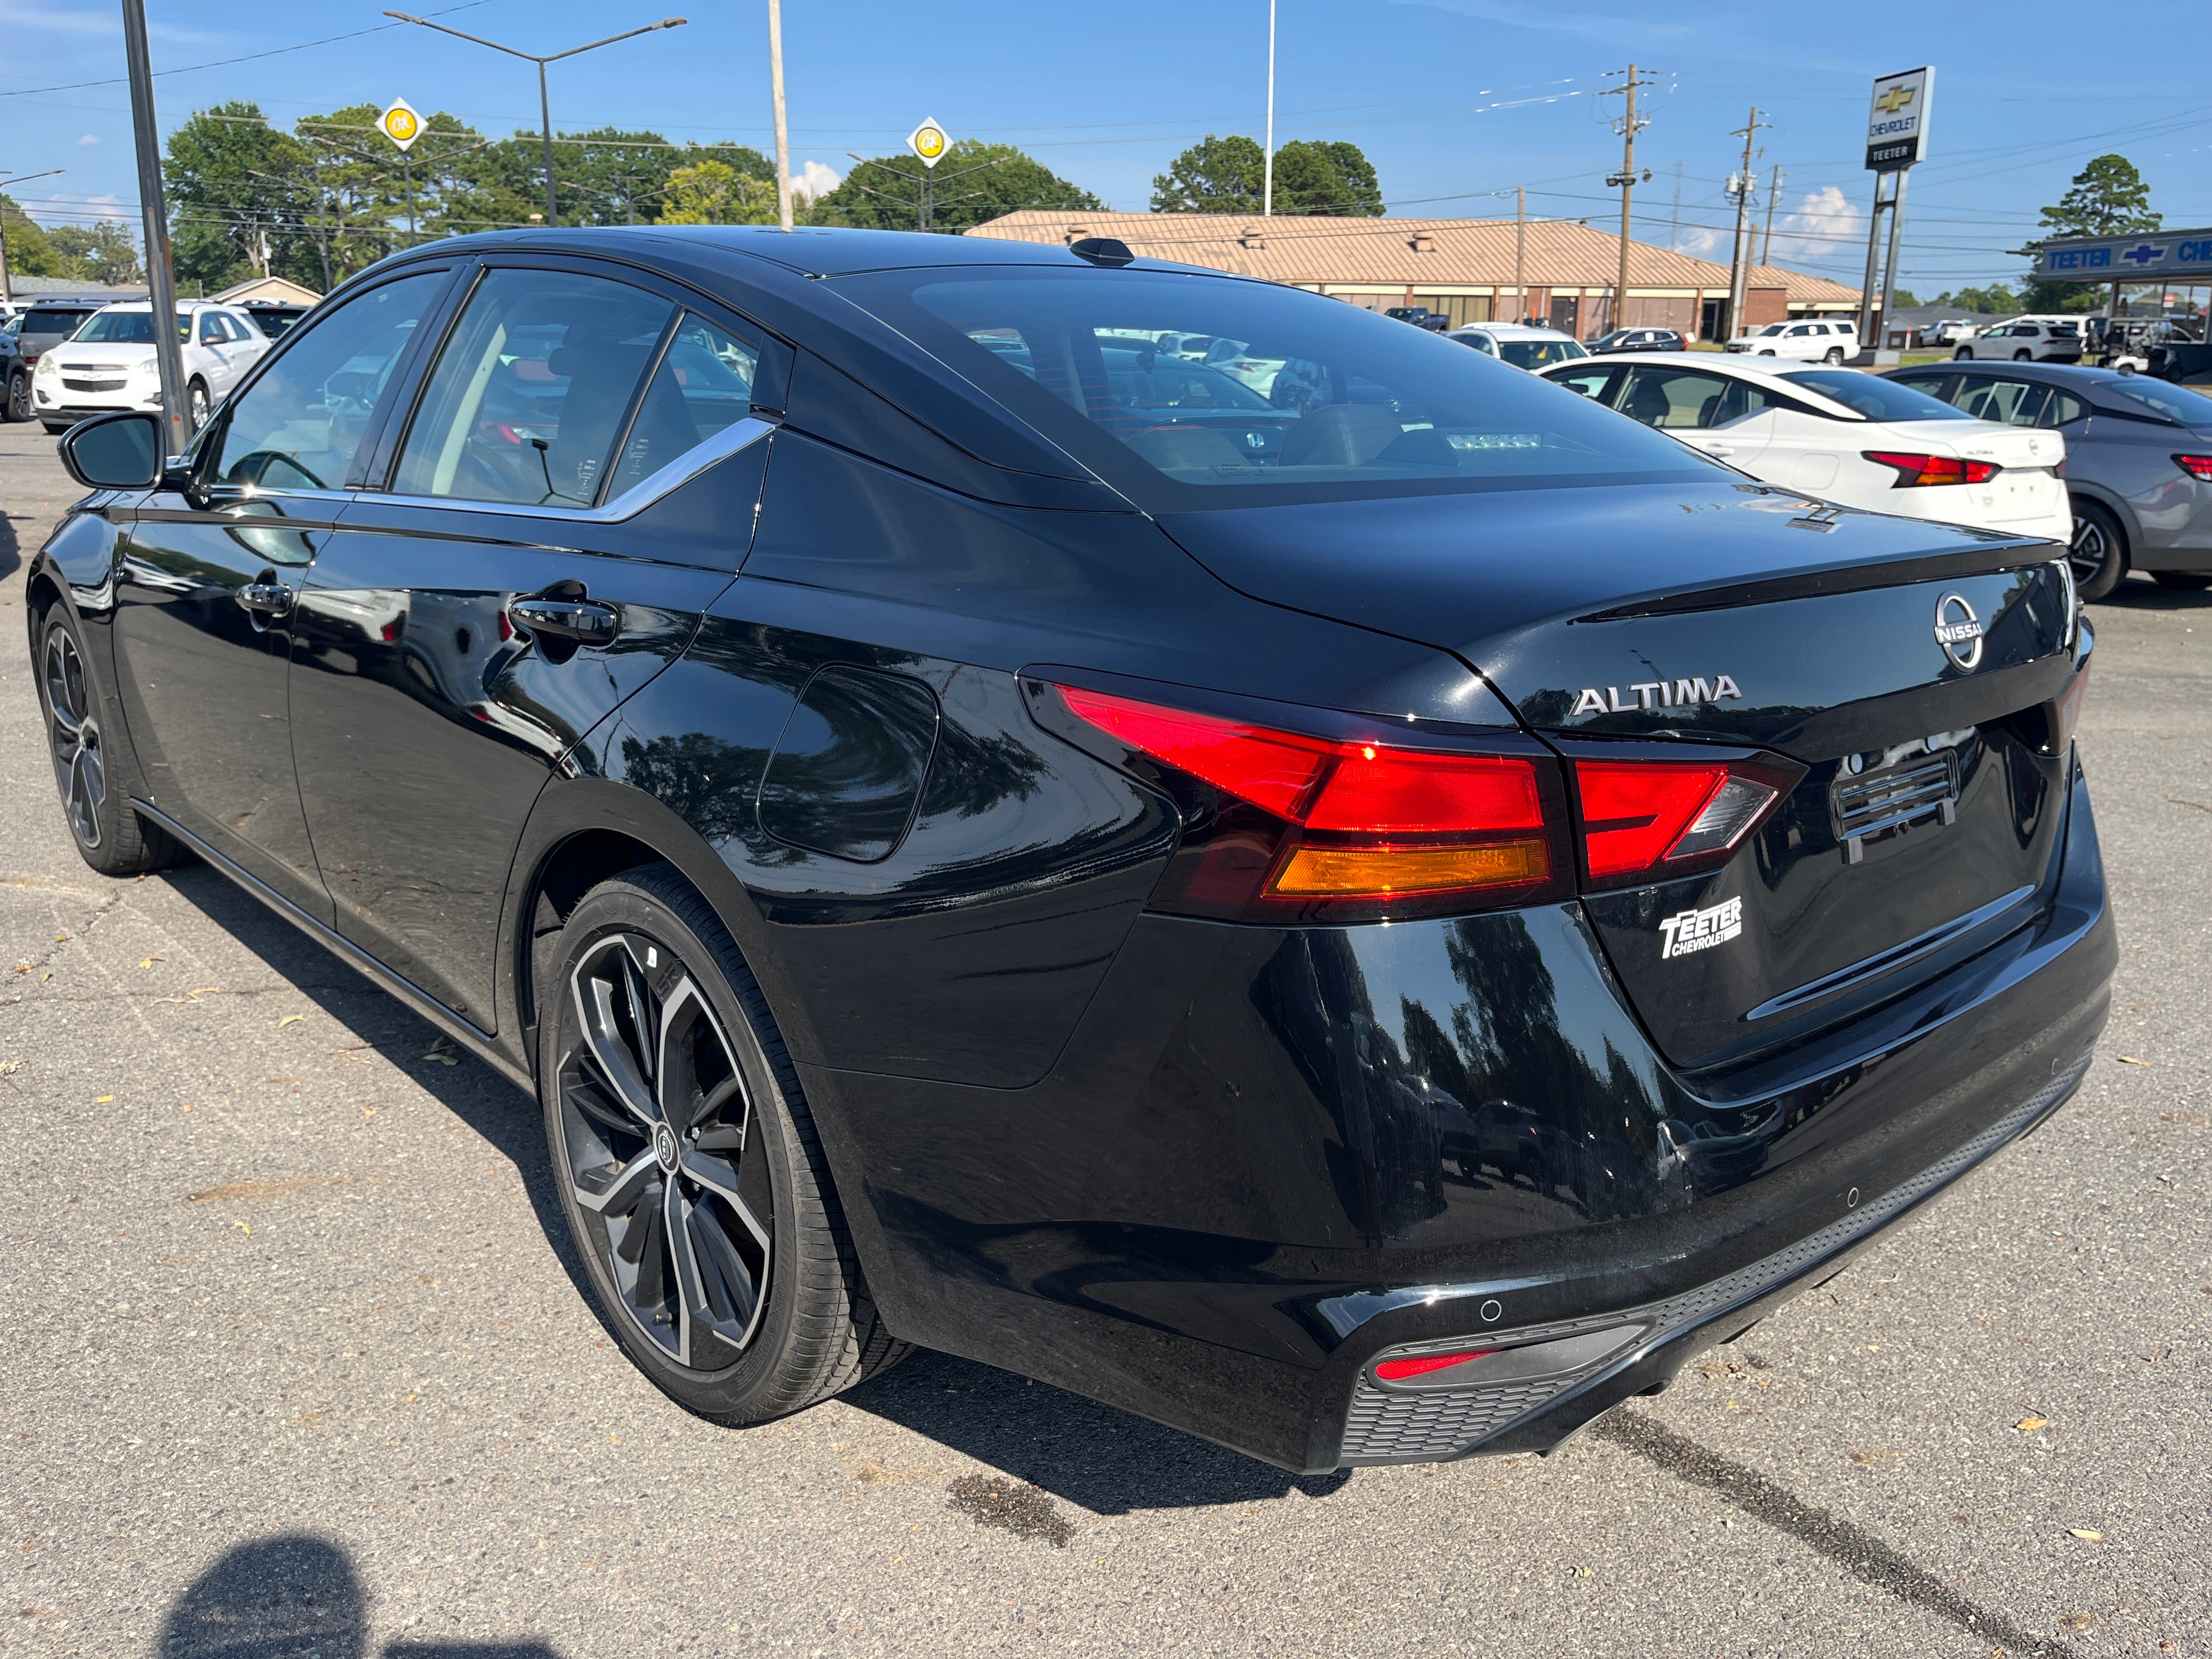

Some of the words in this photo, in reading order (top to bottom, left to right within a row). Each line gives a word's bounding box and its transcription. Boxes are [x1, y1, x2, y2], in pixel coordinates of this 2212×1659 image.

[391, 114, 412, 132] OK
[1870, 116, 1916, 137] CHEVROLET
[921, 133, 939, 150] OK
[1873, 145, 1908, 161] TEETER
[2049, 248, 2111, 270] TEETER
[1938, 622, 1983, 642] NISSAN
[1568, 675, 1742, 716] ALTIMA
[1660, 899, 1742, 959] TEETER
[1672, 932, 1724, 957] CHEVROLET
